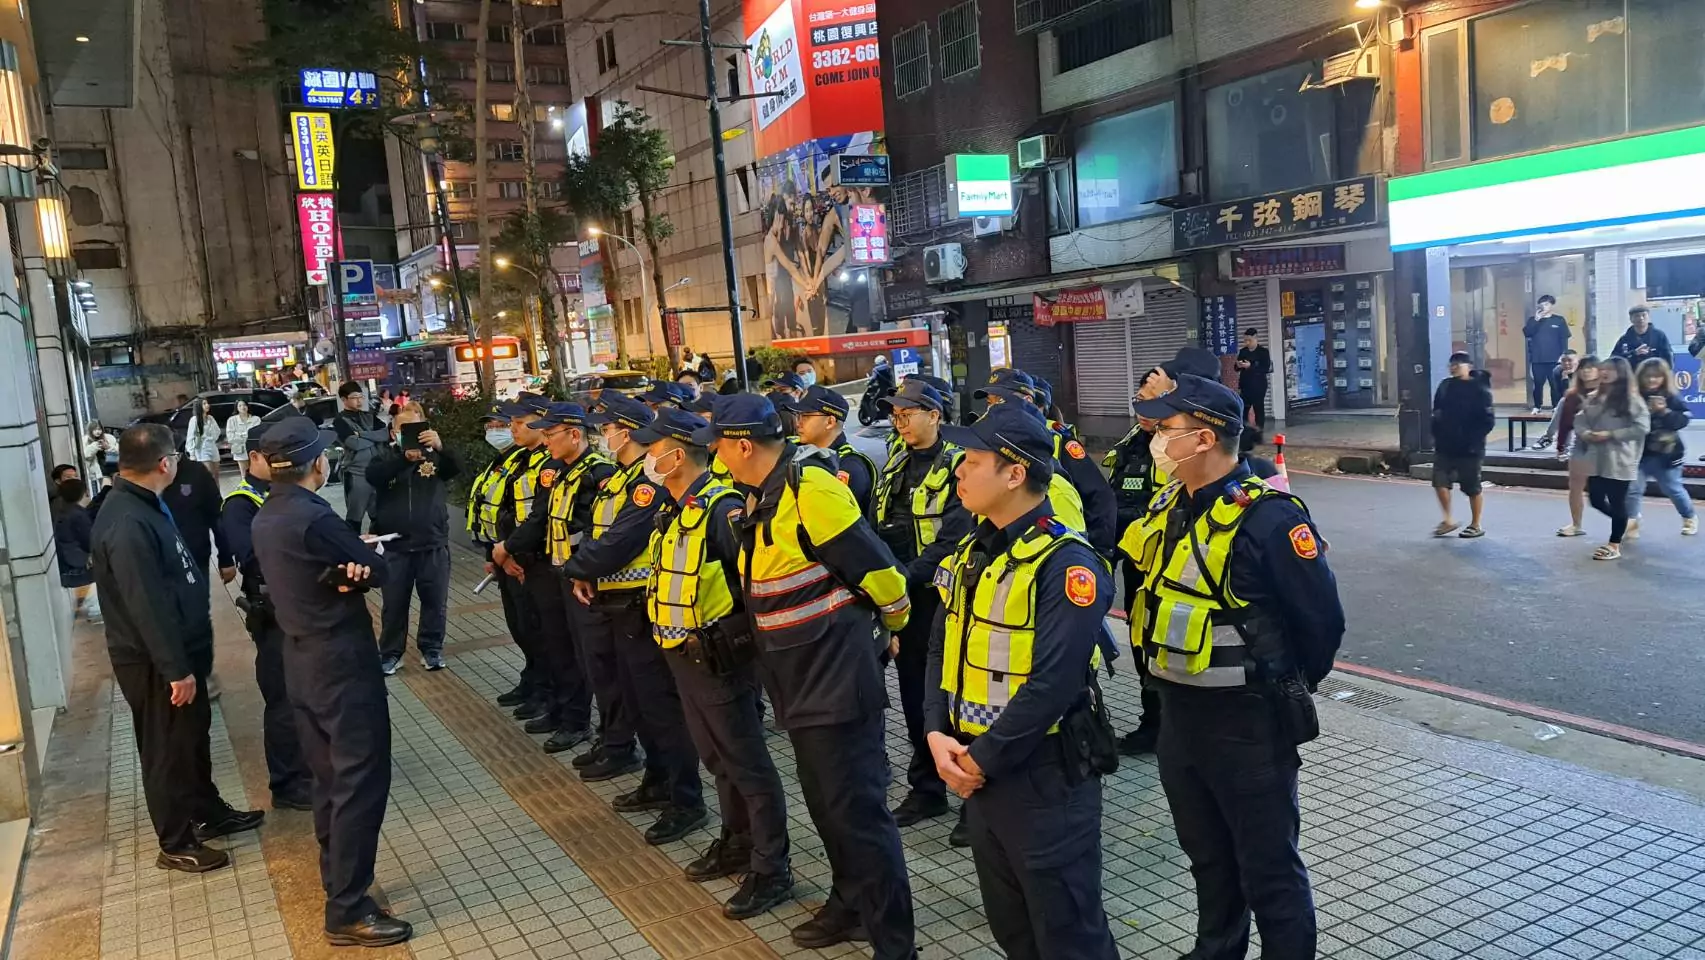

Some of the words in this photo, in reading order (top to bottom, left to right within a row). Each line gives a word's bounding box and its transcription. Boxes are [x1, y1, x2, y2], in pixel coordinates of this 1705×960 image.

[813, 21, 878, 44] 桃園復興店
[764, 64, 789, 94] GYM
[815, 71, 845, 86] COME
[847, 67, 869, 82] JOIN
[872, 65, 880, 79] U
[299, 117, 315, 185] 333-1444
[960, 191, 1009, 203] FamilyMart
[1216, 183, 1366, 232] 千弦鋼琴
[340, 264, 364, 293] P
[233, 349, 263, 359] HOTEL
[900, 349, 910, 363] P
